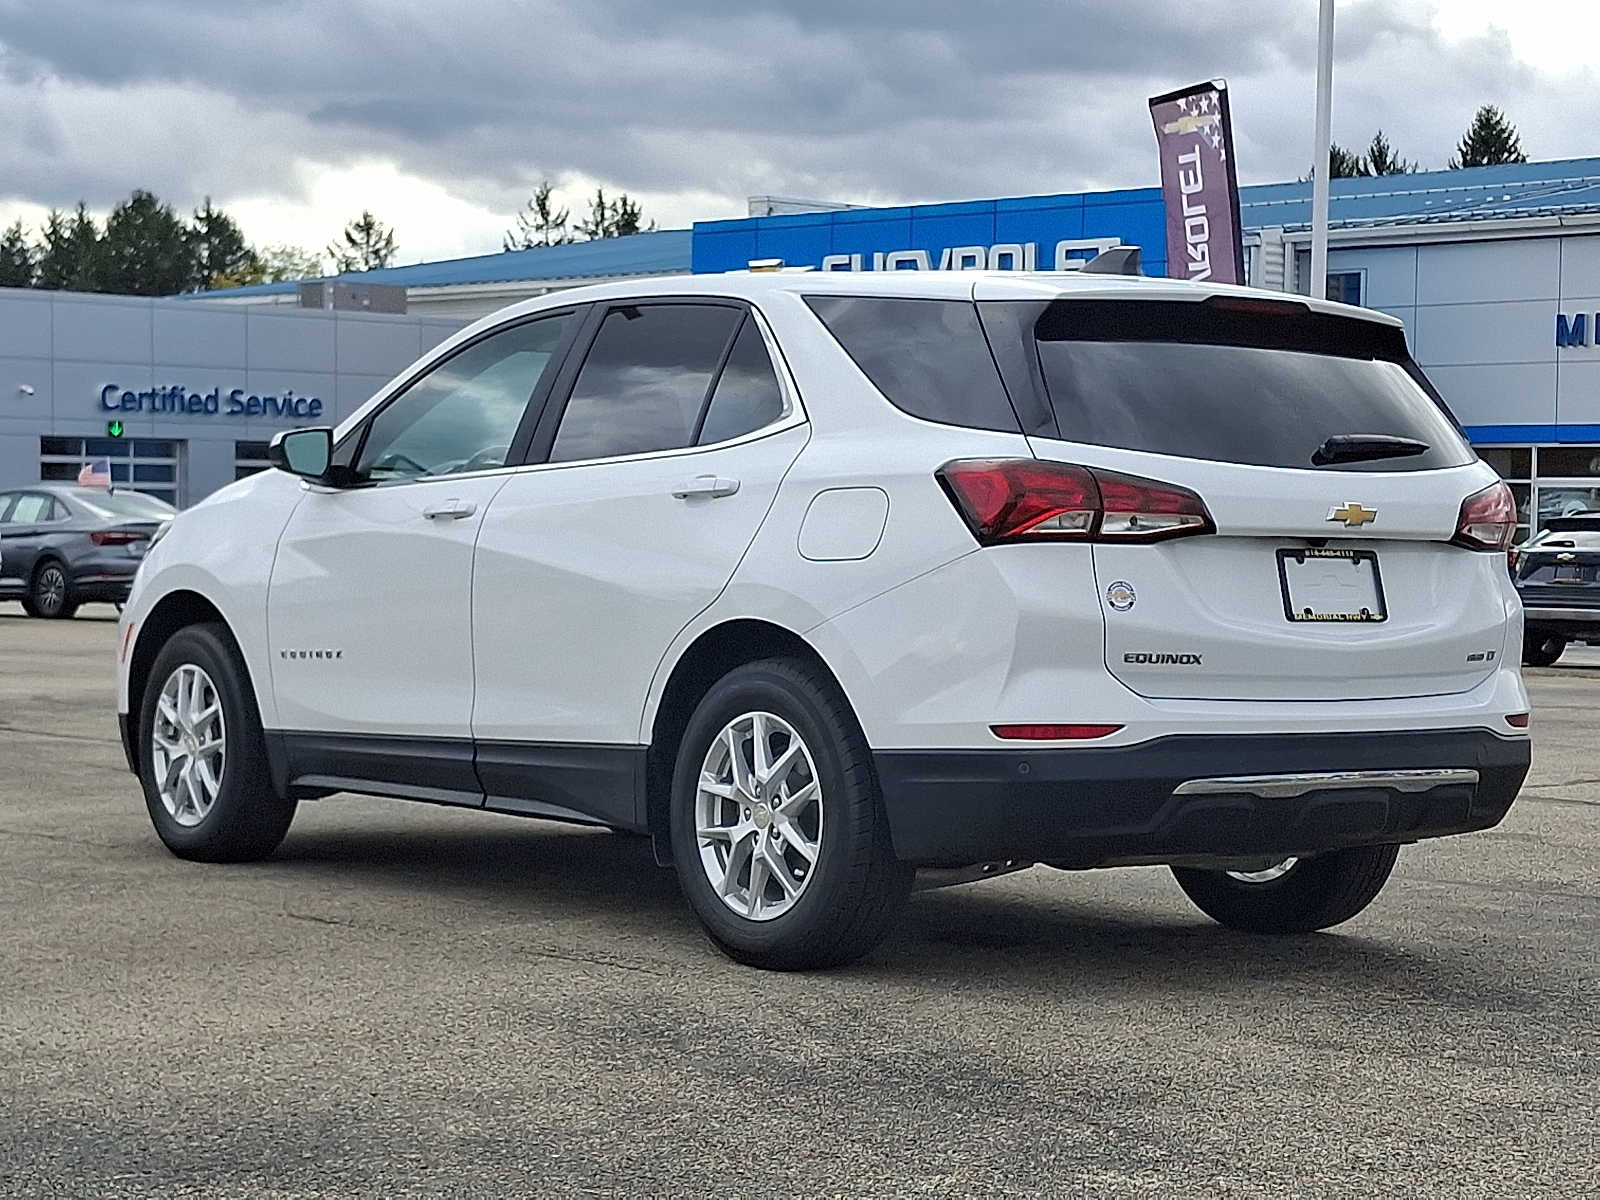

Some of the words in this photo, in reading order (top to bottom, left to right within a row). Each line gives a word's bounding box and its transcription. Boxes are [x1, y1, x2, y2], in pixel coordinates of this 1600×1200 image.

[1556, 312, 1600, 348] M
[101, 383, 219, 415] Certified
[226, 388, 323, 418] Service
[1123, 652, 1203, 665] EQUINOX
